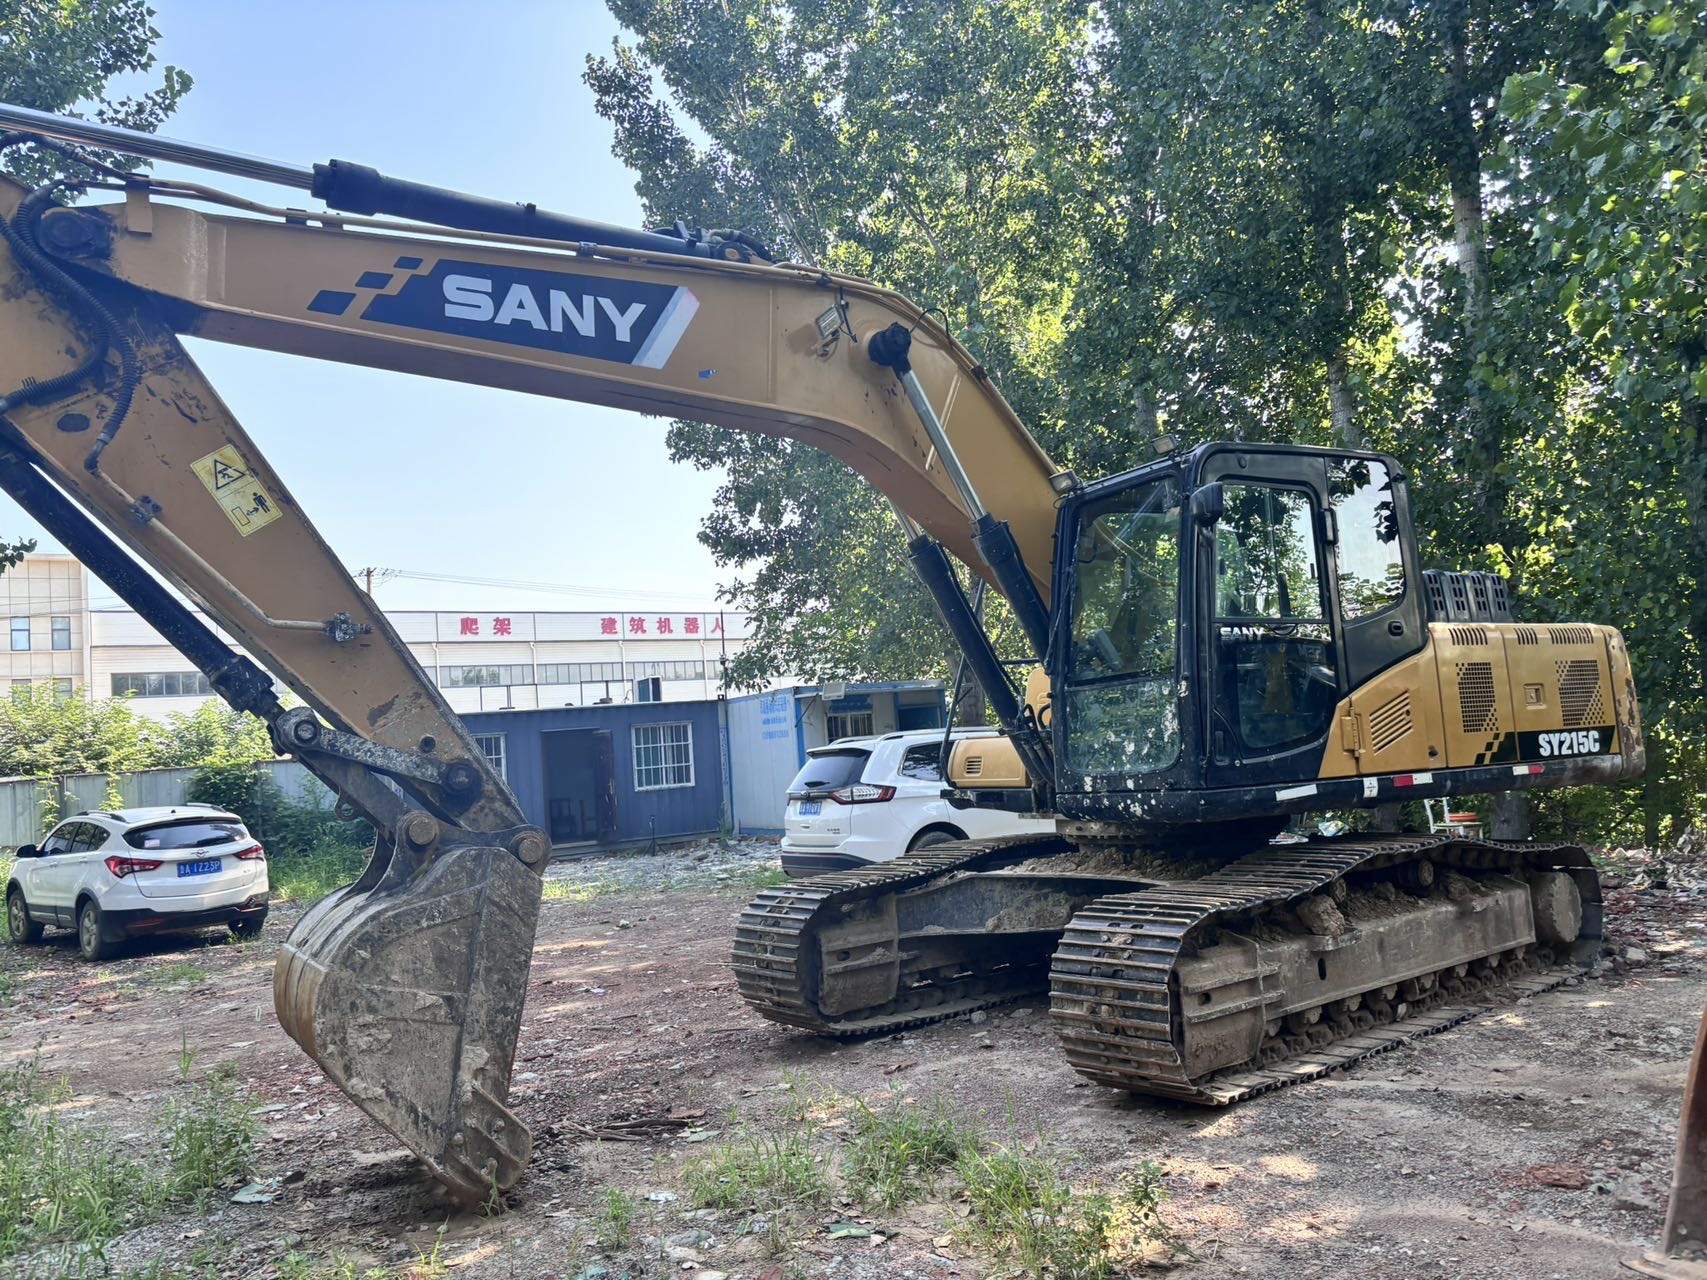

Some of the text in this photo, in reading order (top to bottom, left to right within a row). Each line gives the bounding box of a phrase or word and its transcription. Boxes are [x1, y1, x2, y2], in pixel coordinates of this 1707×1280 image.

[442, 273, 647, 343] SANY
[460, 616, 725, 636] 爬架 建筑机器人
[1220, 626, 1265, 641] SANY
[1538, 730, 1600, 757] SY215C
